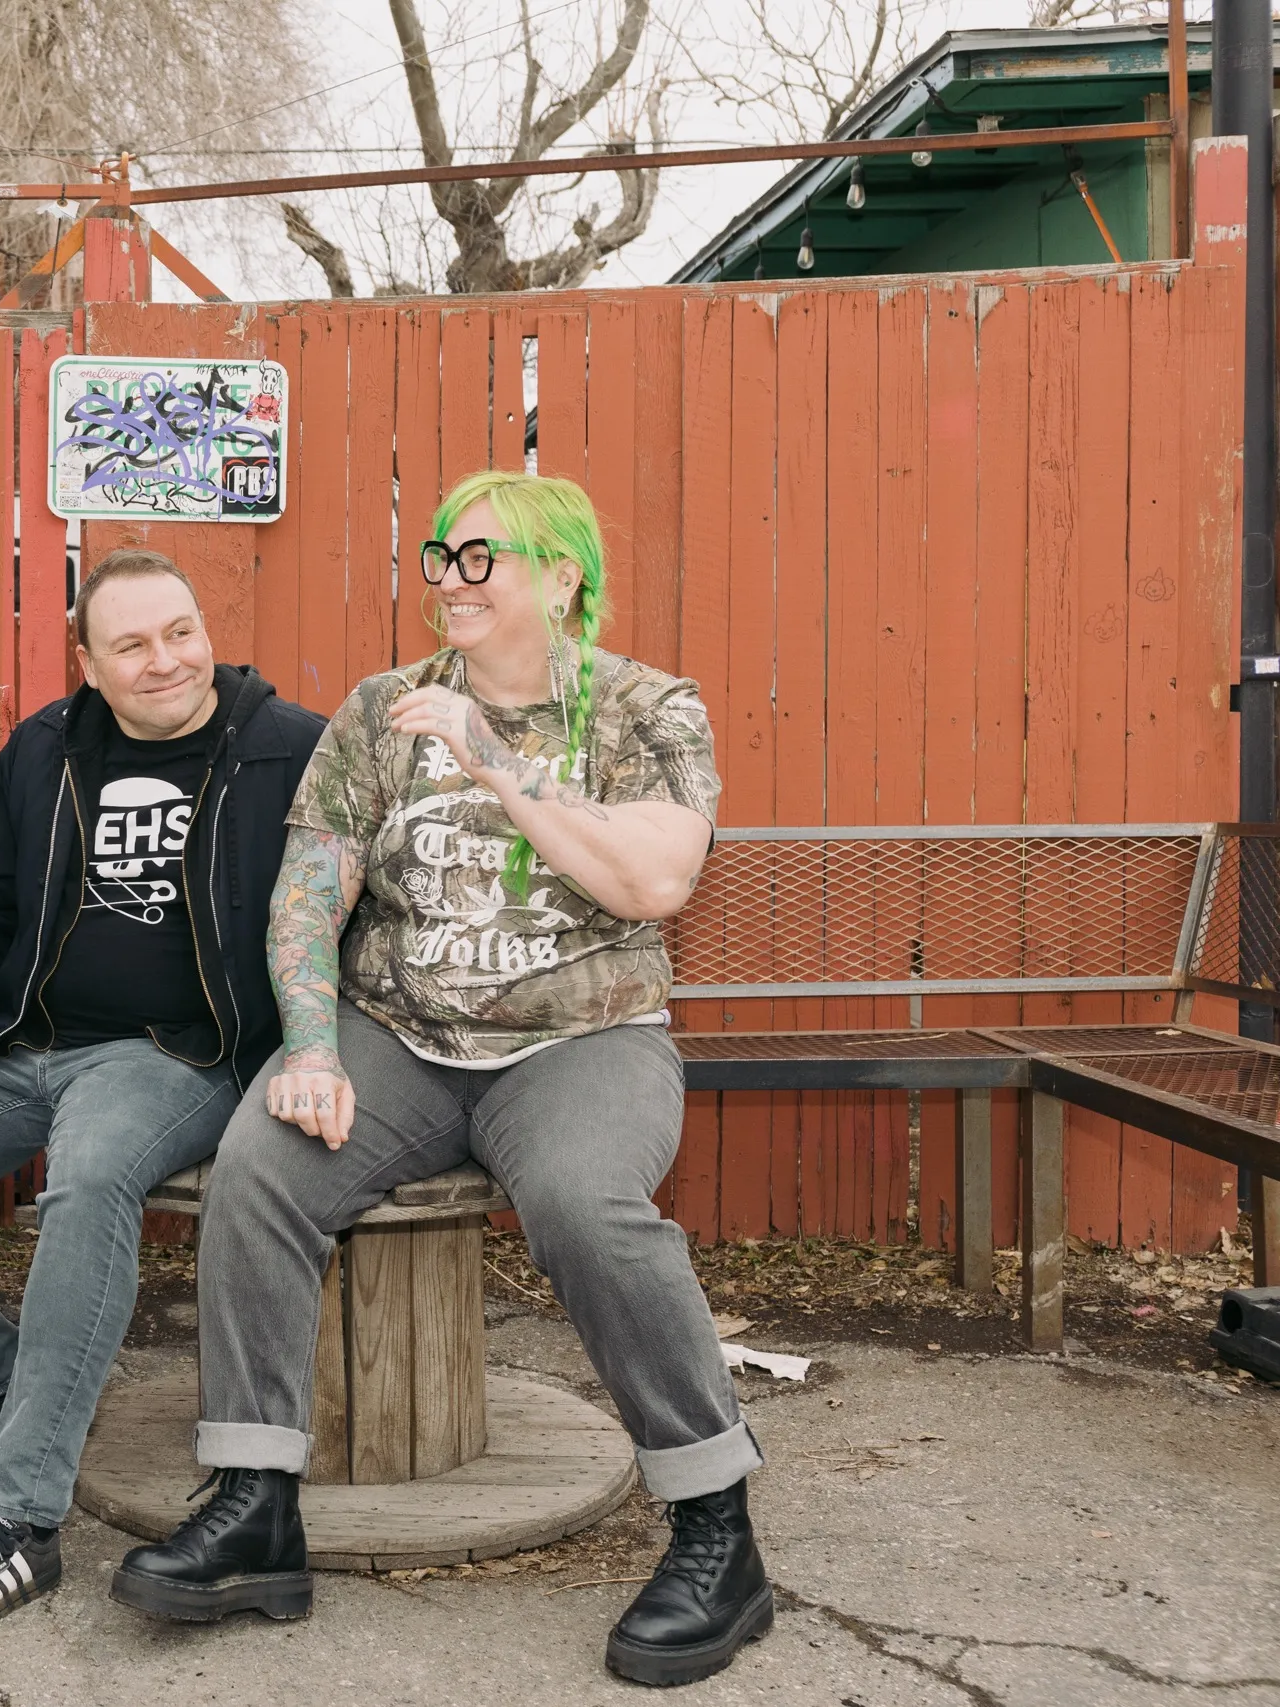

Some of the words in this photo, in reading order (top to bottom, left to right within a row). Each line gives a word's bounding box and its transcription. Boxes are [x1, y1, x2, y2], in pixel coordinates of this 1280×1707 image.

[86, 380, 252, 414] BICE
[228, 466, 277, 502] PBS
[418, 735, 588, 782] Pect
[94, 805, 192, 855] EHS
[412, 822, 556, 877] Tra
[405, 921, 561, 974] Folks
